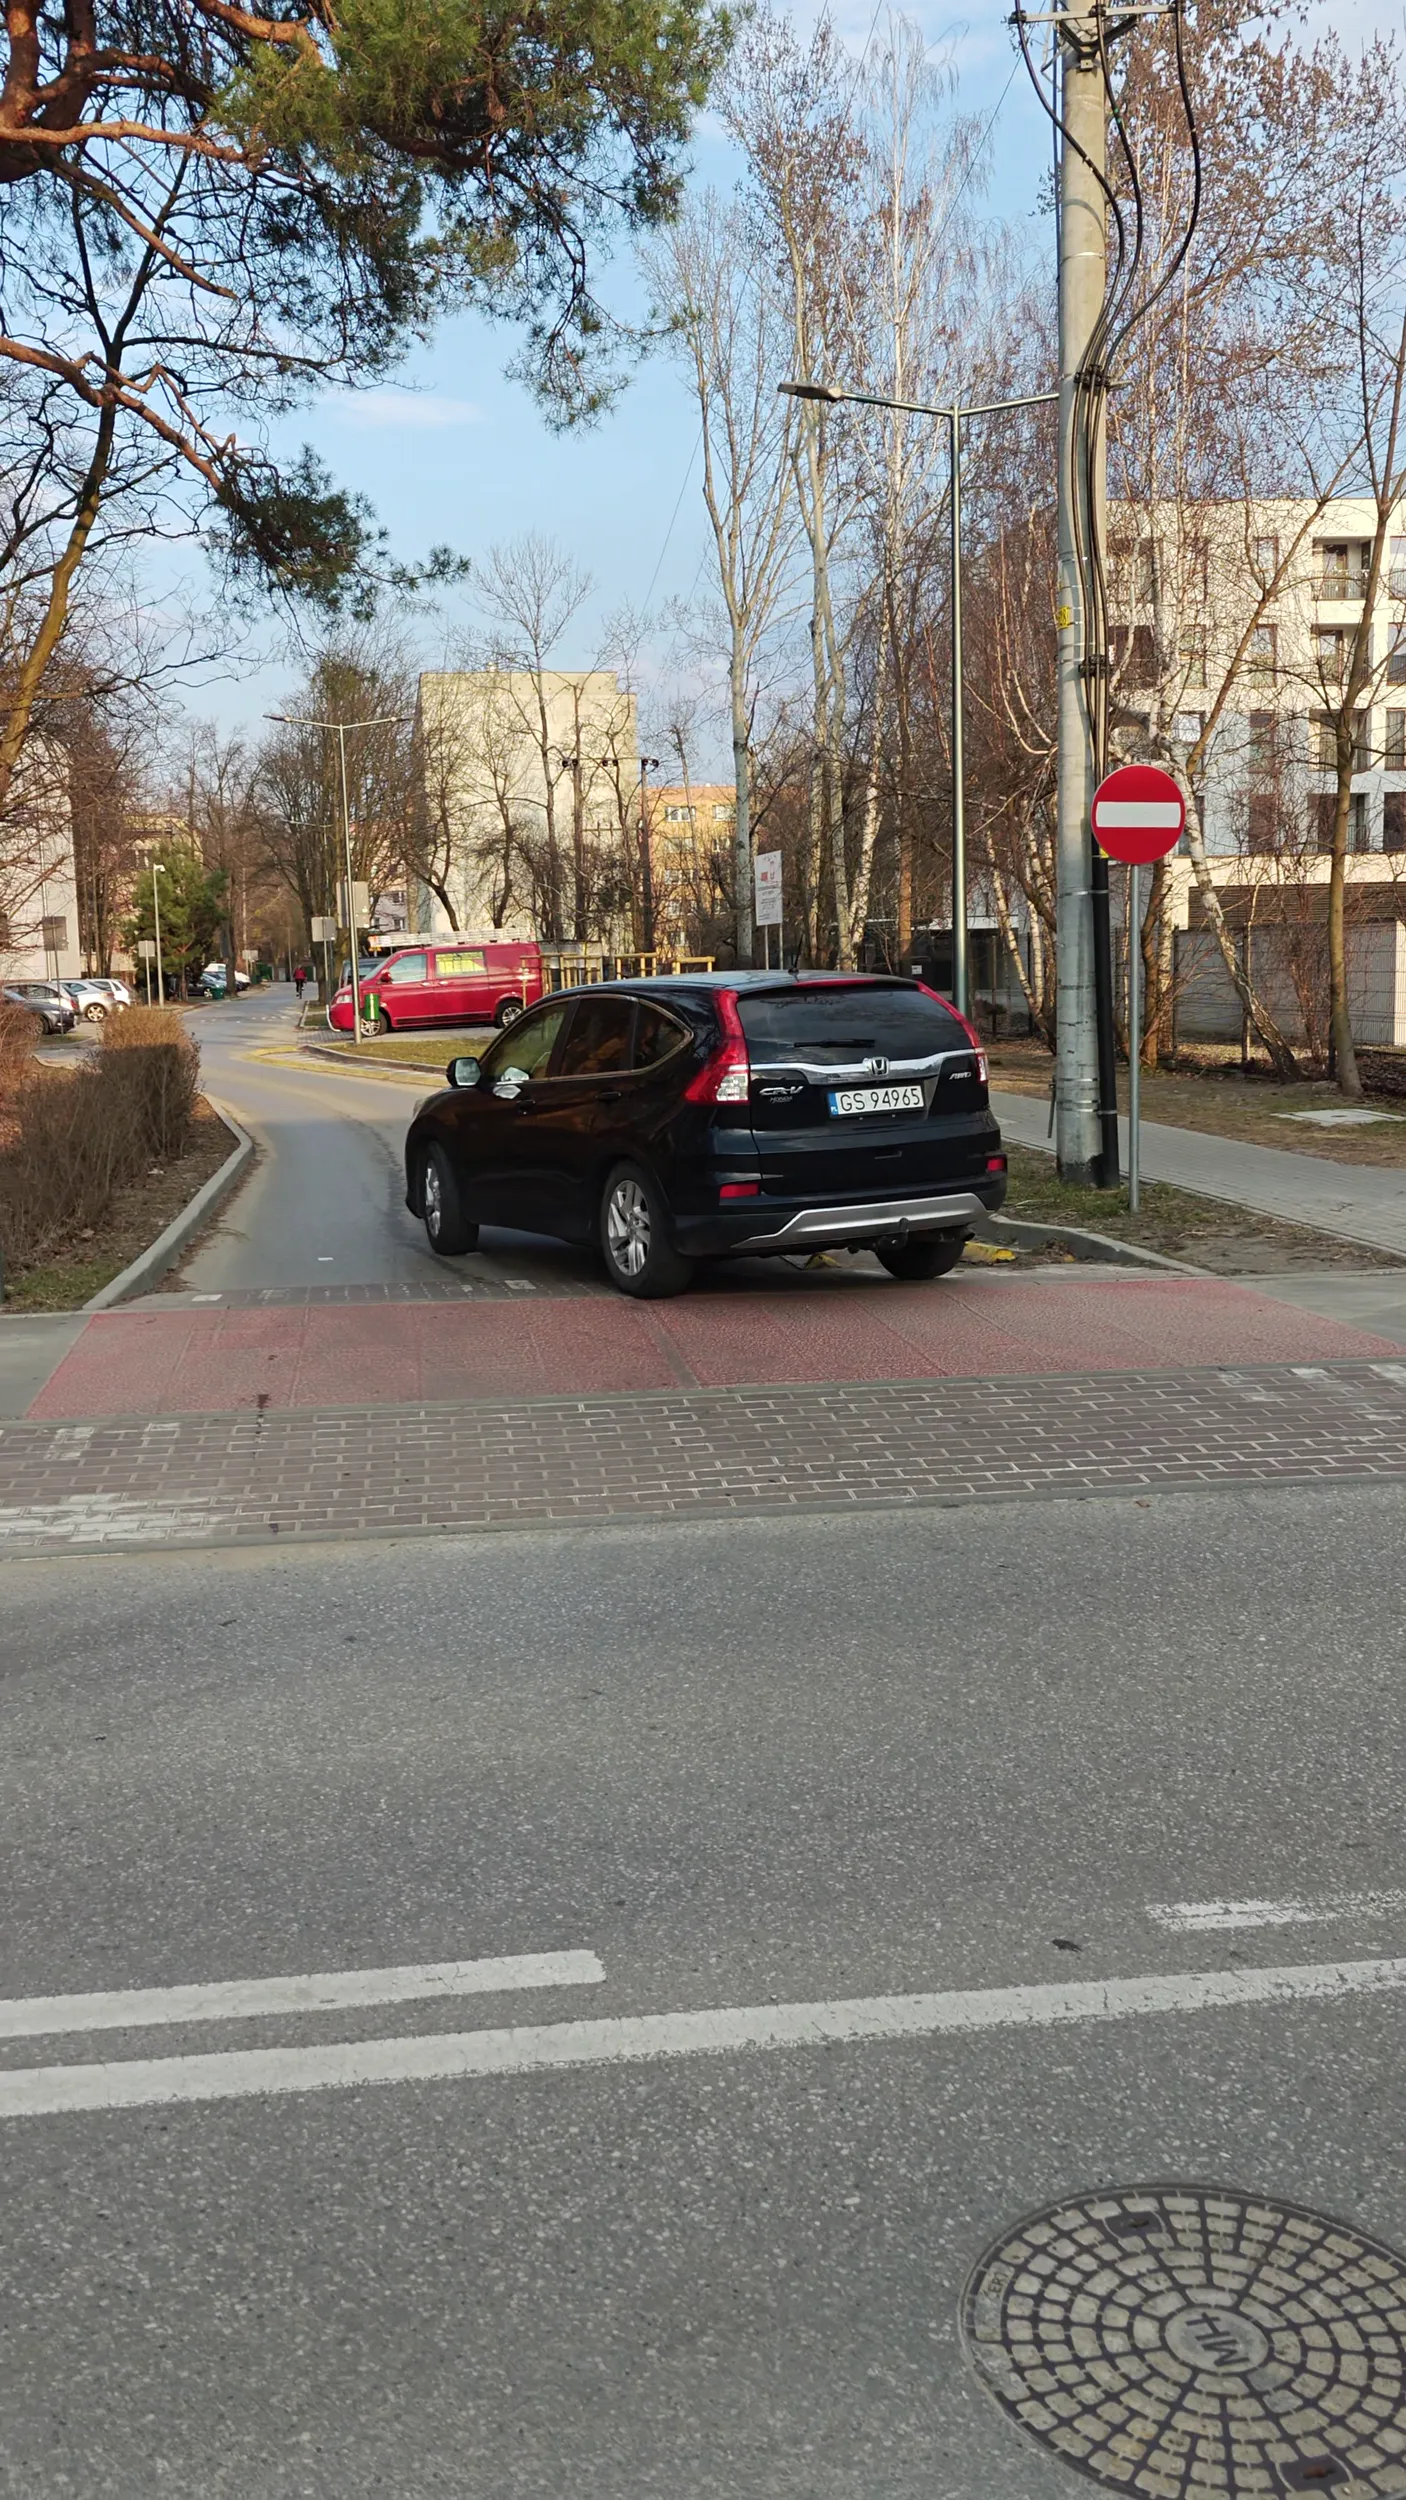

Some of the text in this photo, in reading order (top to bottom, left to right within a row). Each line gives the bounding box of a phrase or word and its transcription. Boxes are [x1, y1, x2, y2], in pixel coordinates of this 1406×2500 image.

[759, 1085, 804, 1096] CR-V
[840, 1087, 920, 1112] GS 94965
